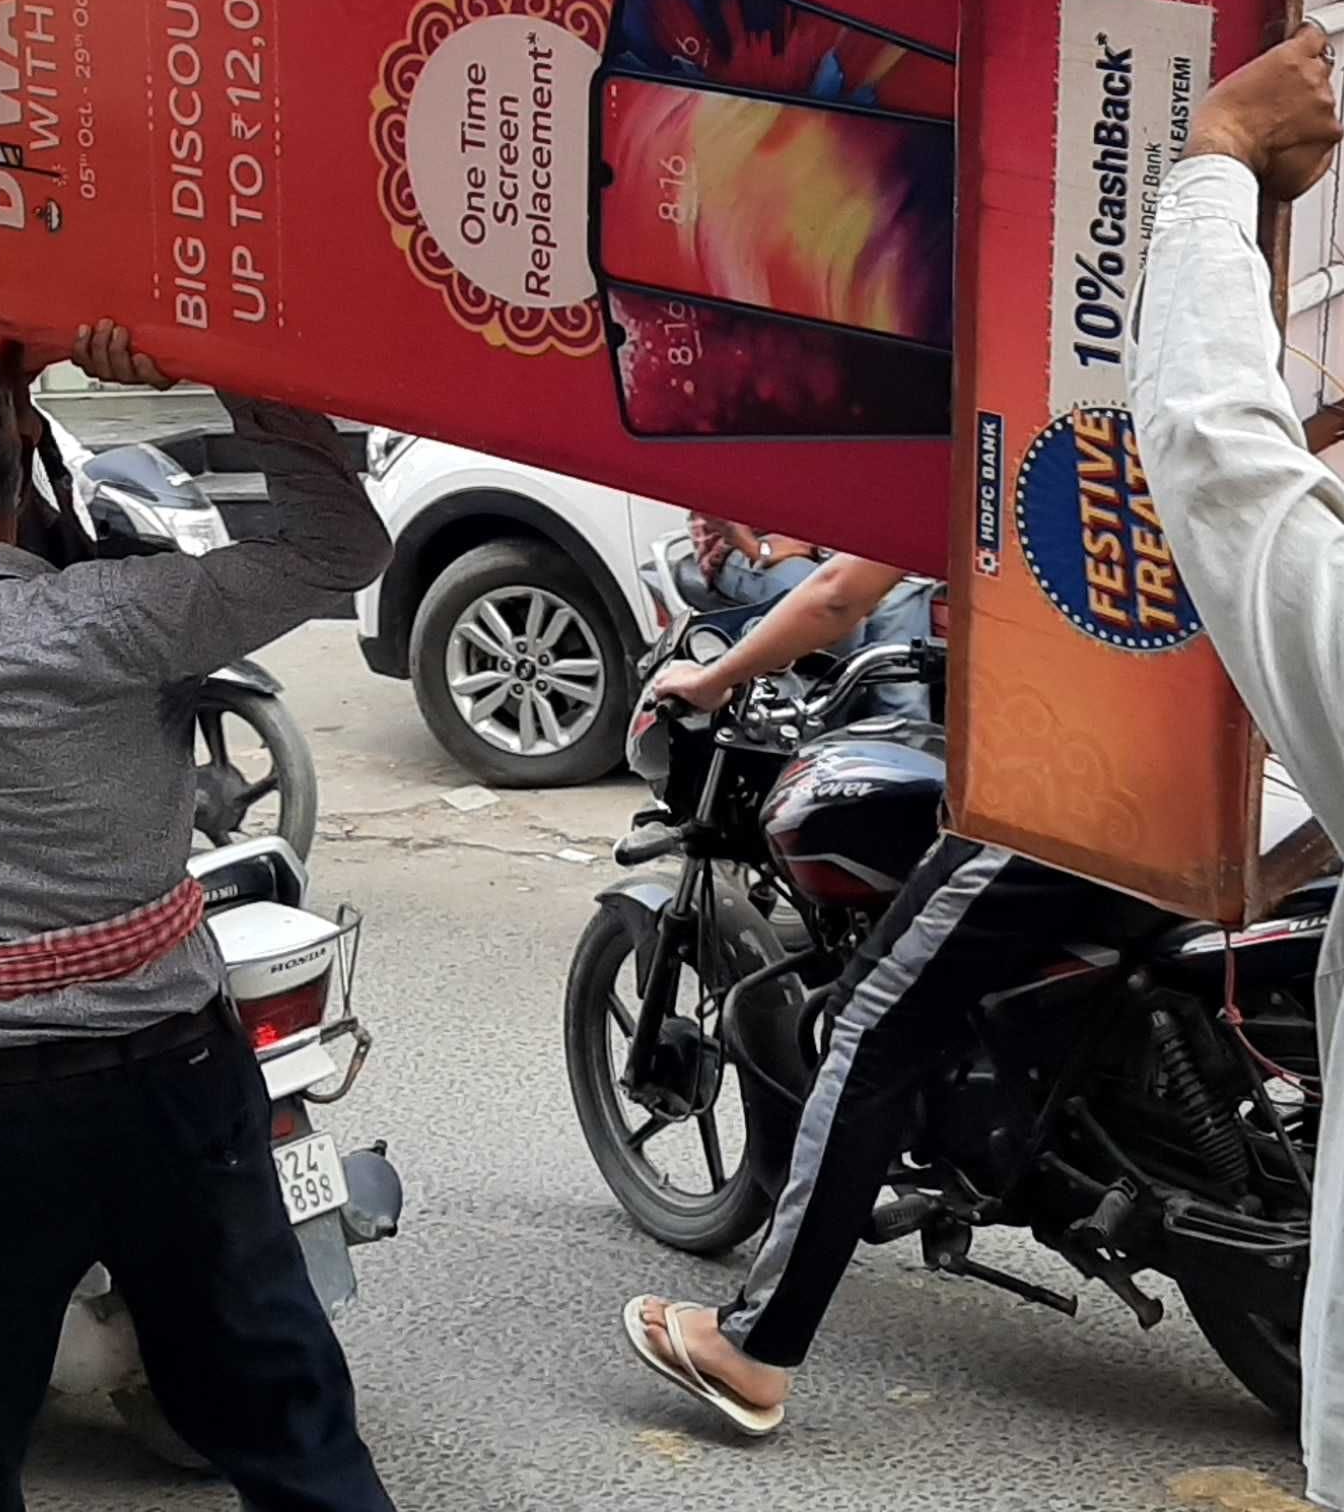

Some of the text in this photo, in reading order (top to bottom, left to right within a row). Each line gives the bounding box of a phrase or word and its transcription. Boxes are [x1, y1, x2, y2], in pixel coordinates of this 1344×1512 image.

[23, 3, 61, 151] WITH
[227, 152, 266, 228] TO
[459, 60, 488, 246] One Time
[492, 93, 520, 227] Screen
[1142, 141, 1162, 190] Bank
[173, 235, 210, 330] BIG
[230, 244, 268, 324] UP
[980, 421, 997, 542] HDFC BANK
[1073, 407, 1130, 627] FESTIVE
[269, 947, 327, 974] HONDA
[289, 1174, 334, 1213] 898
